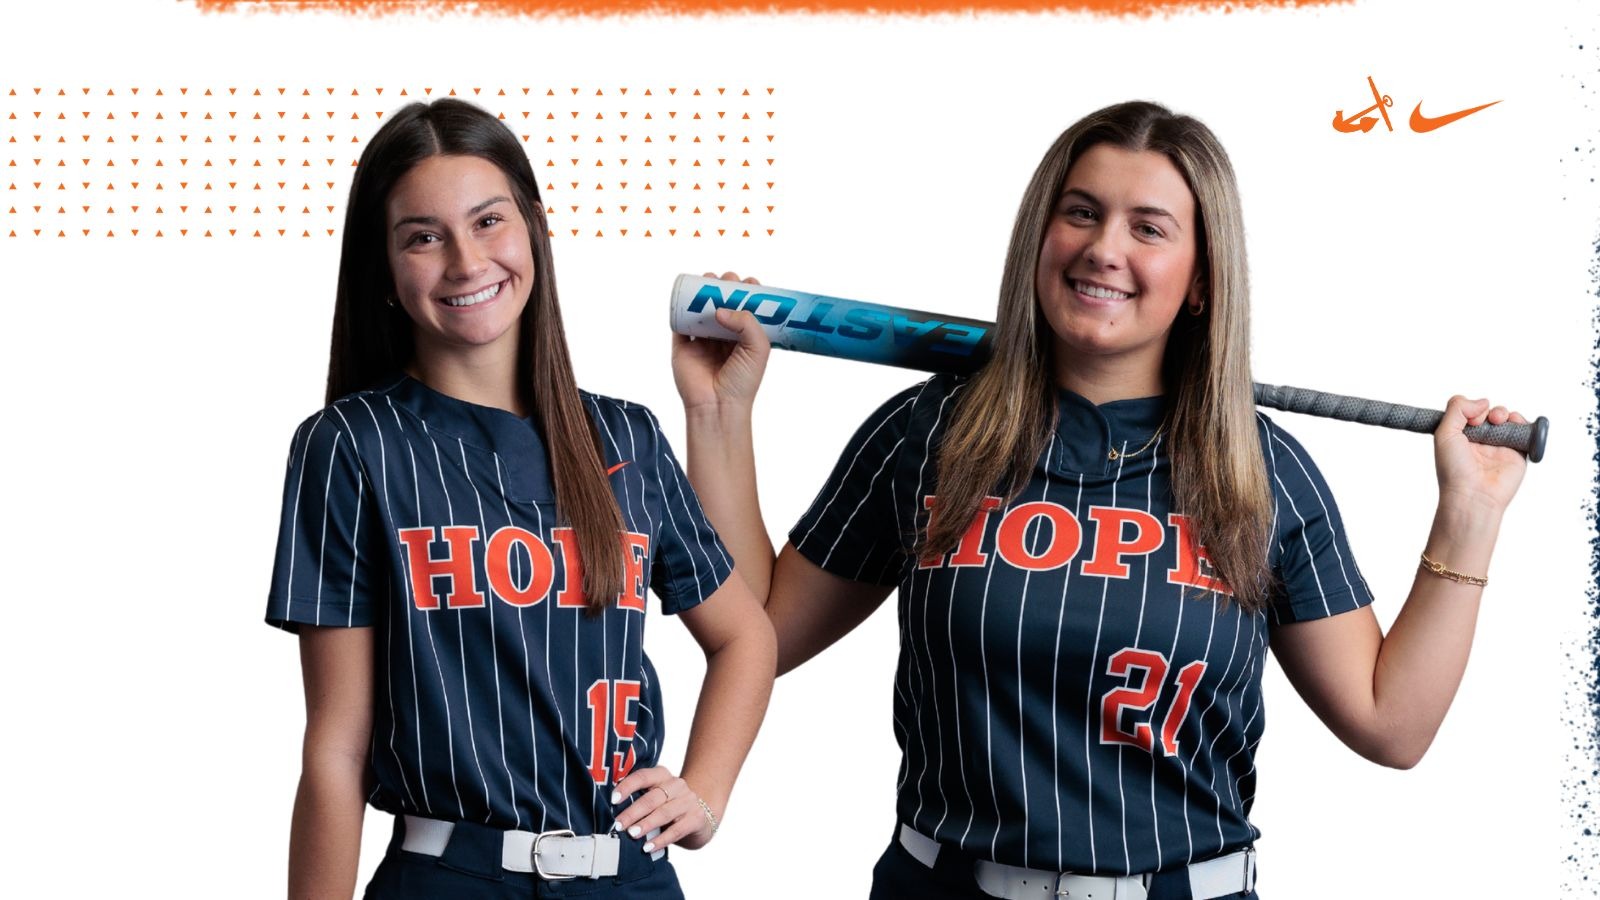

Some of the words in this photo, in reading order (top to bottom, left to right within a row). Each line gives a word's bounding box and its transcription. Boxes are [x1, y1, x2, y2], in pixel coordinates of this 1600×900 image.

[687, 284, 988, 356] EASTON
[586, 679, 641, 786] 15
[1099, 647, 1209, 758] 21
